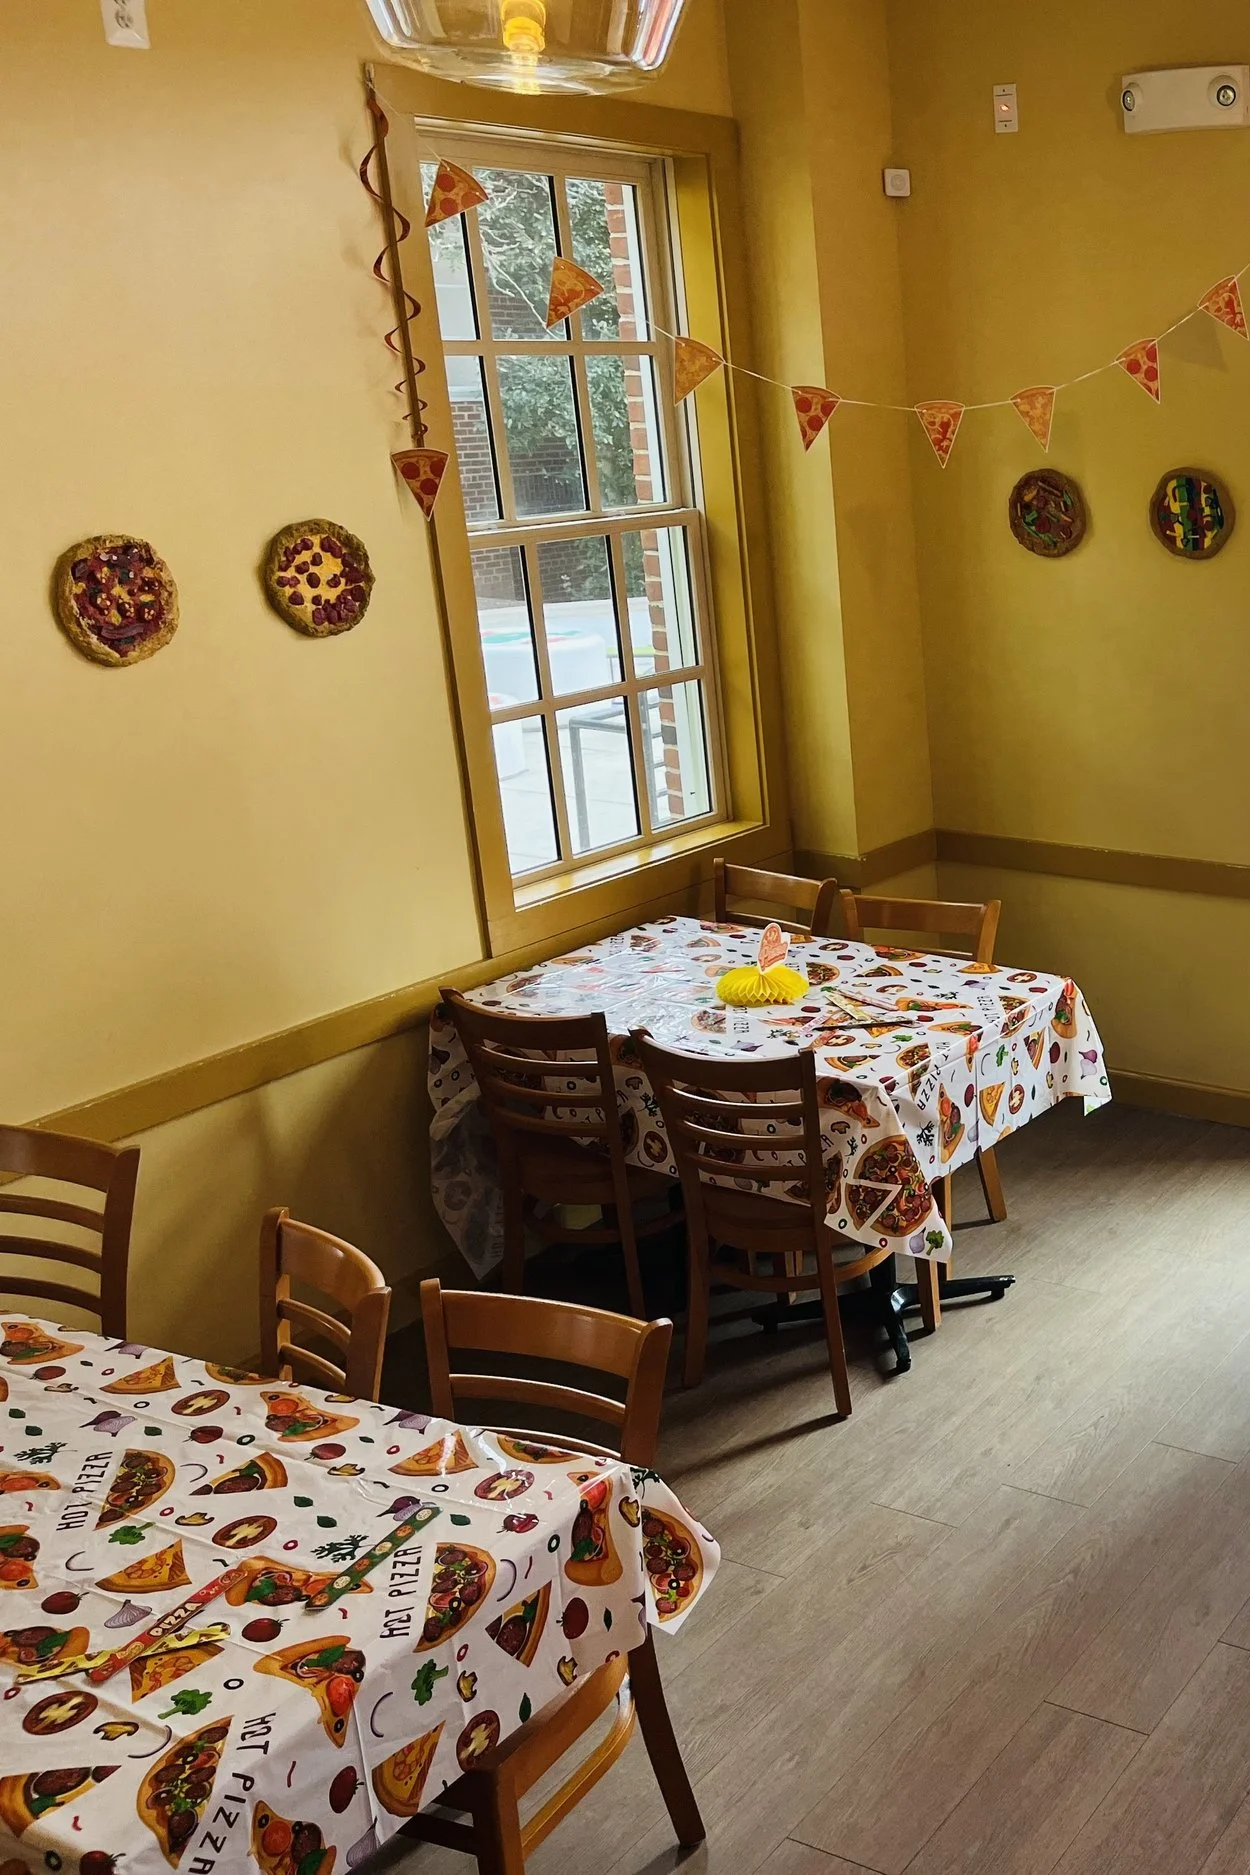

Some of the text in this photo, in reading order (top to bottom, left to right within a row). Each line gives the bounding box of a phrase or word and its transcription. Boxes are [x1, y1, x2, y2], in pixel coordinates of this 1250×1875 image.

[56, 1451, 113, 1531] HOT PIZZA
[150, 1602, 203, 1637] PIZZA
[380, 1546, 423, 1638] HOT PIZZA
[188, 1712, 276, 1875] HOT PIZZA
